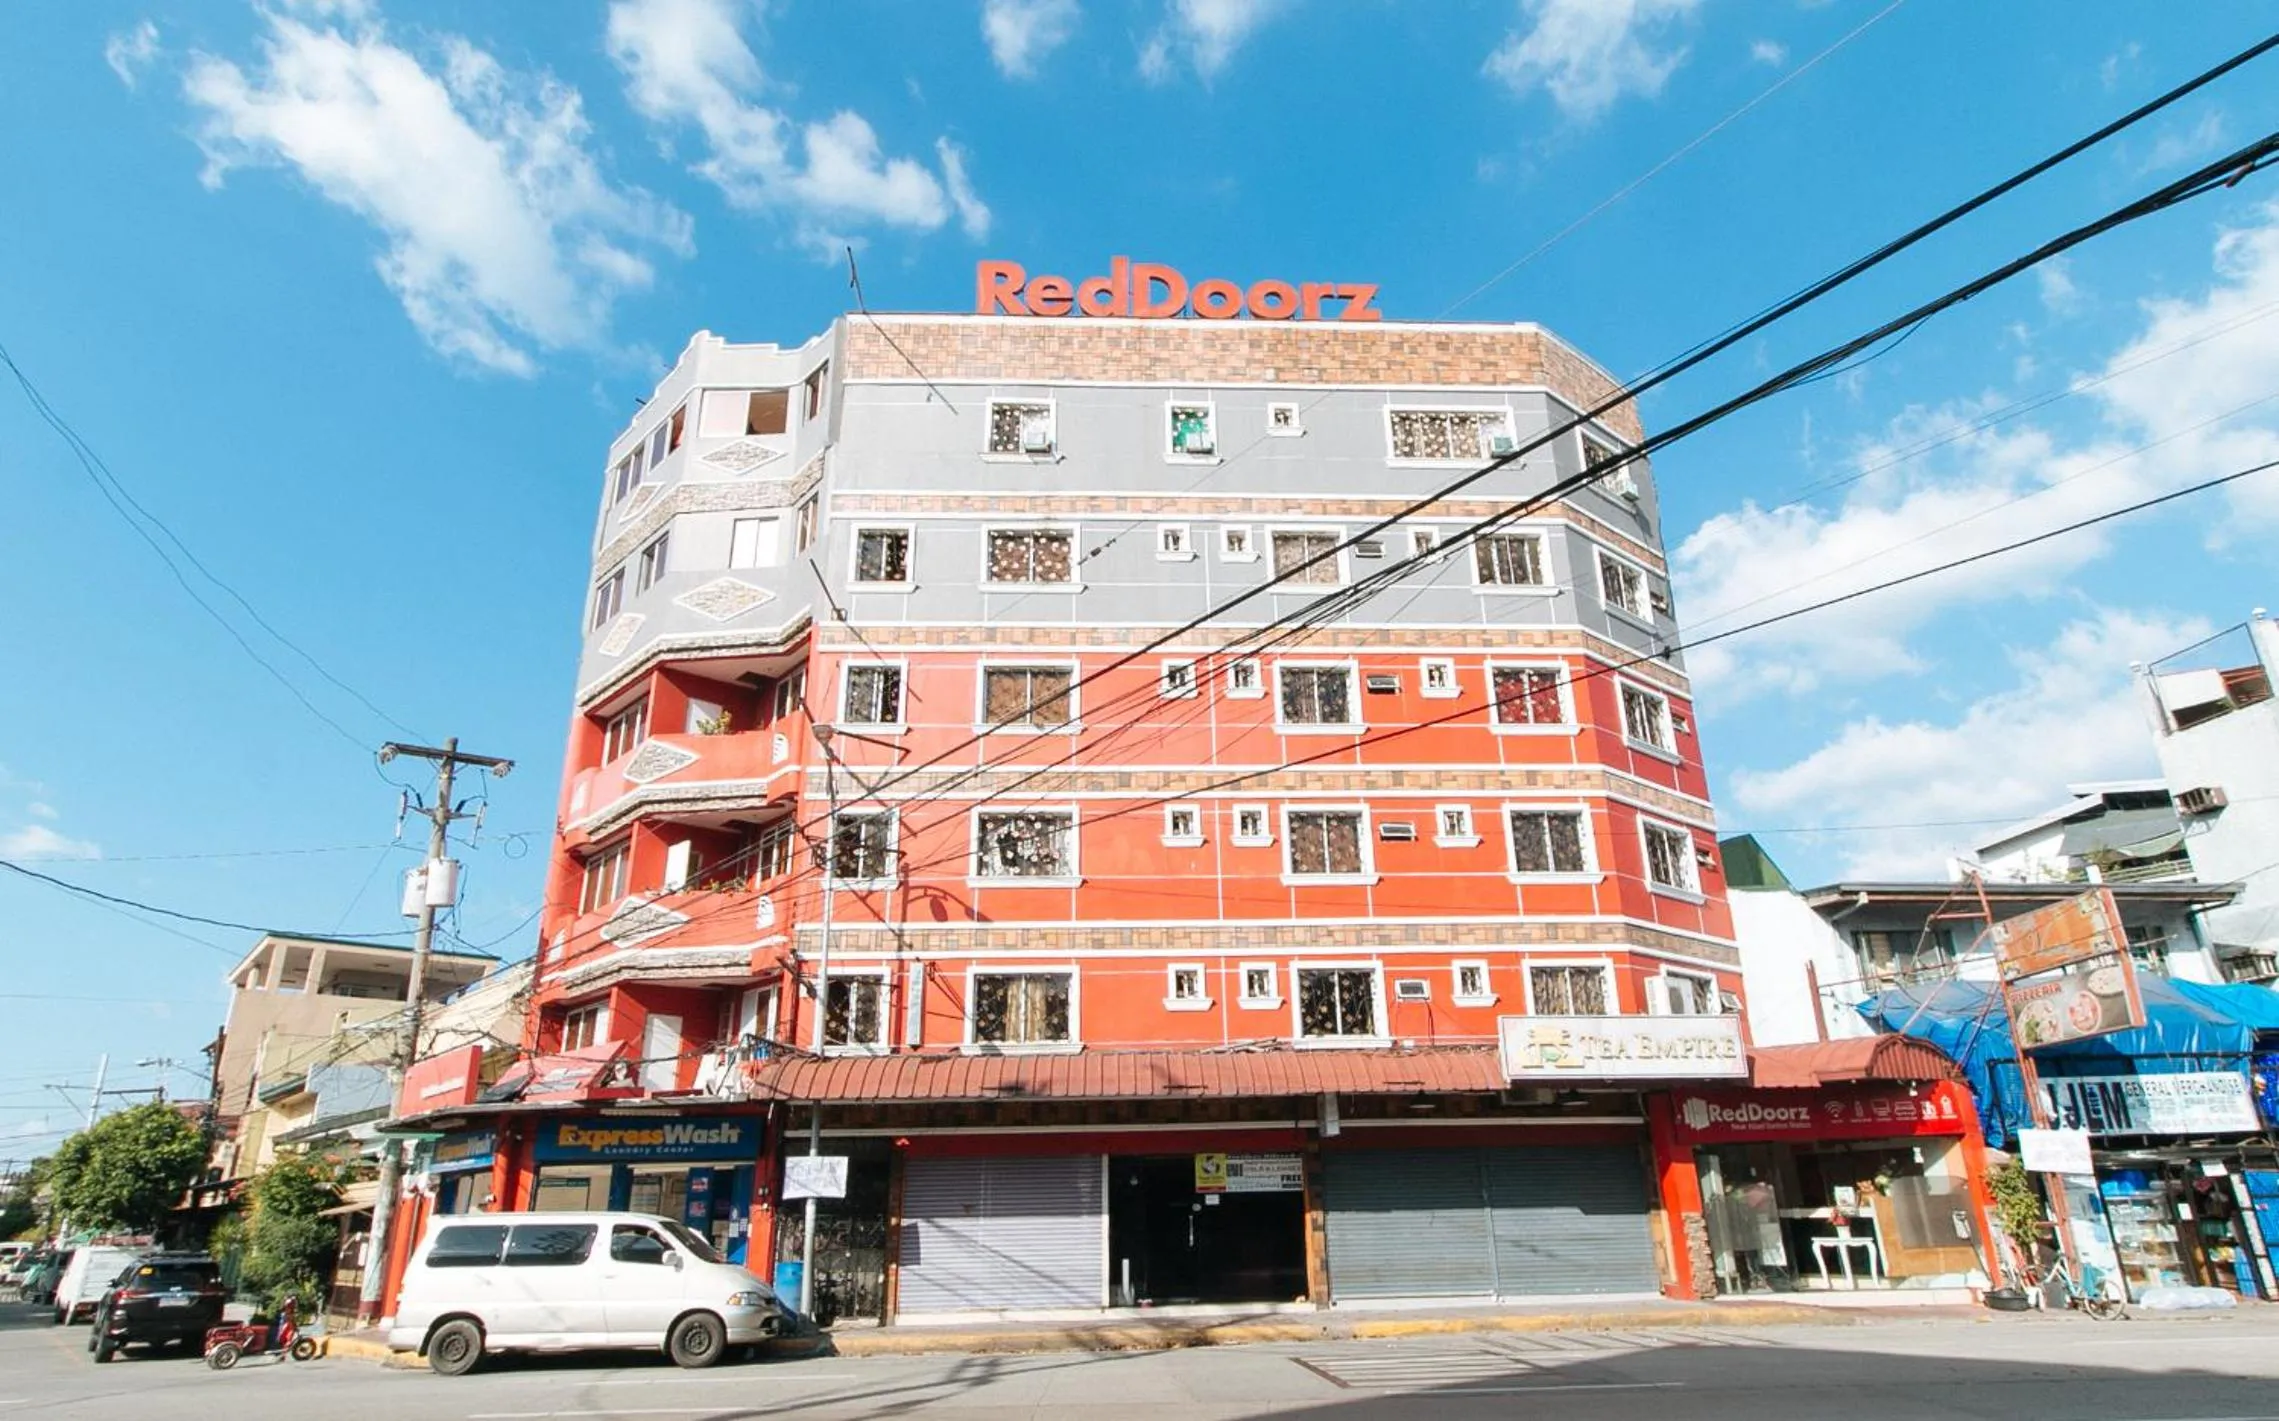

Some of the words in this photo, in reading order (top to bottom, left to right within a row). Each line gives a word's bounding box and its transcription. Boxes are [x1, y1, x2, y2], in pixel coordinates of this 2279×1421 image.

[976, 255, 1381, 320] RedDoorz
[1580, 1035, 1632, 1060] TEA
[1634, 1033, 1737, 1060] EMPIRE
[1708, 1102, 1811, 1122] RedDoorz
[558, 1121, 740, 1152] ExpressWash
[604, 1146, 650, 1155] Laundry
[656, 1146, 694, 1154] Center
